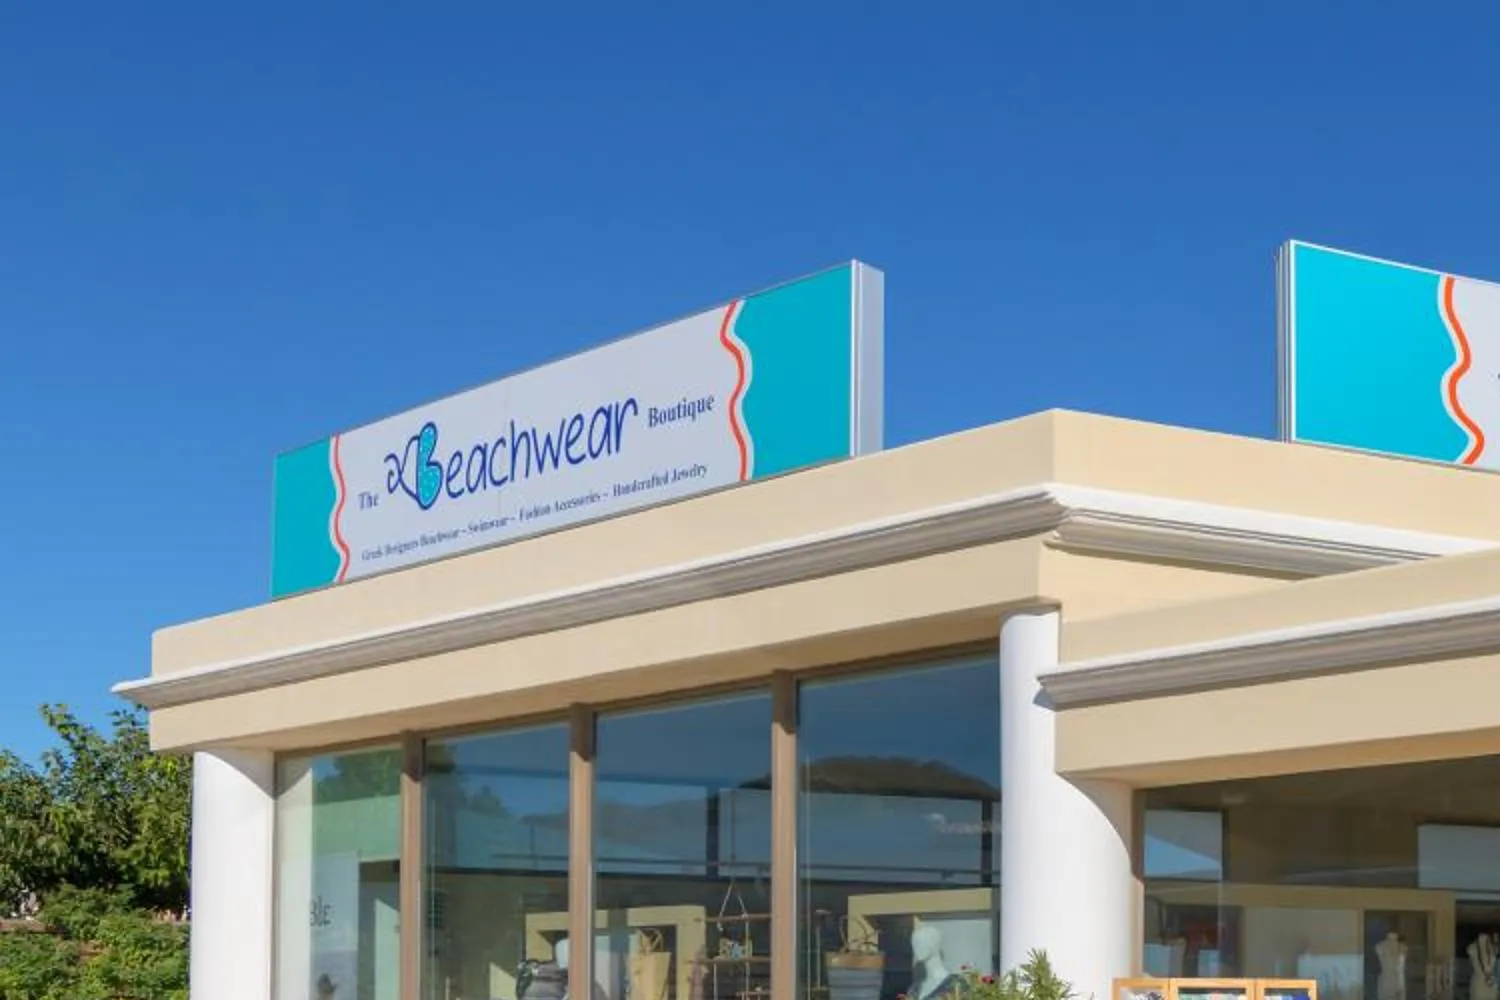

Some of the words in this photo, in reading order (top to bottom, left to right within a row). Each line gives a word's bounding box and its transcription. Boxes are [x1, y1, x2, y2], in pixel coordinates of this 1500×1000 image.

[358, 491, 379, 510] The
[384, 397, 638, 510] Beachwear
[648, 395, 715, 429] Boutique
[612, 471, 669, 497] Handcrafted
[671, 462, 708, 483] Jewelry
